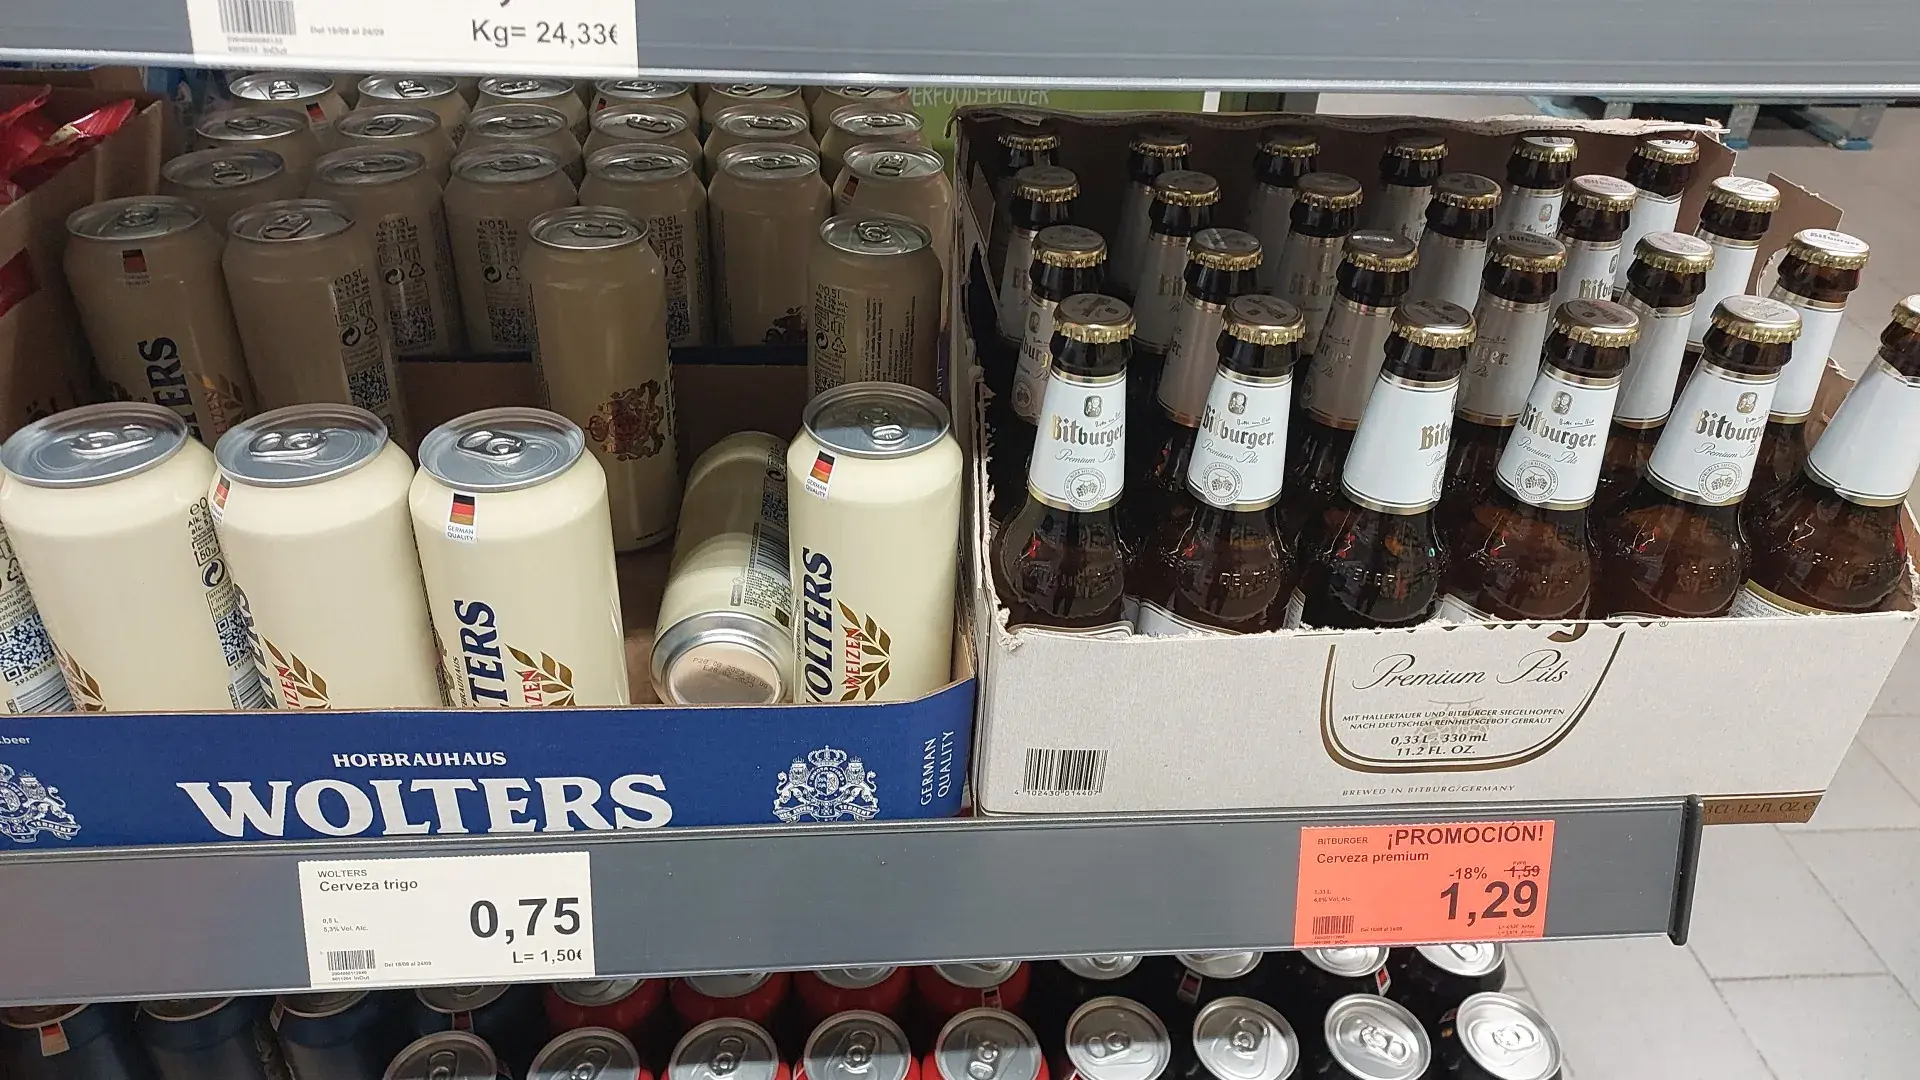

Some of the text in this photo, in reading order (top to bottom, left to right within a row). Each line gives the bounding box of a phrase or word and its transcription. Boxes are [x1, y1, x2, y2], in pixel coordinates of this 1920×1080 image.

[472, 19, 618, 49] Kg= 24,33€
[805, 485, 826, 498] QUALITY
[806, 479, 828, 491] GERMAN
[447, 525, 474, 535] GERMAN
[447, 531, 474, 541] QUALITY
[453, 600, 509, 707] TERS
[846, 627, 863, 690] WEIZEN
[1351, 648, 1570, 690] Premium Pils
[1362, 712, 1422, 721] HALLERTAUER
[1425, 710, 1446, 718] UND
[1448, 709, 1498, 717] BITBURGER
[1500, 708, 1565, 716] SIEGELHOPFEN
[1350, 722, 1376, 730] NACH
[1379, 720, 1432, 729] DEUTSCHEM
[1434, 718, 1509, 726] REINHEITSGEBOT
[1441, 733, 1467, 743] 330
[1397, 745, 1475, 756] 11.2 FL. OZ.
[332, 751, 507, 769] HOFBRAUHAUS
[938, 730, 955, 798] QUALITY
[920, 737, 937, 806] GERMAN
[1342, 784, 1515, 796] BREWED IN BITBURG/GERMANY
[176, 774, 673, 838] WOLTERS
[1317, 822, 1544, 851] BITBURGER ¡PROMOCIÓN!
[1316, 850, 1430, 865] Cerveza premium
[317, 869, 368, 878] WOLTERS
[1449, 866, 1488, 881] -18%
[319, 879, 419, 893] Cerveza trigo
[1440, 879, 1540, 928] 1,29
[470, 897, 581, 945] 0,75
[512, 949, 583, 965] L= 1,50€
